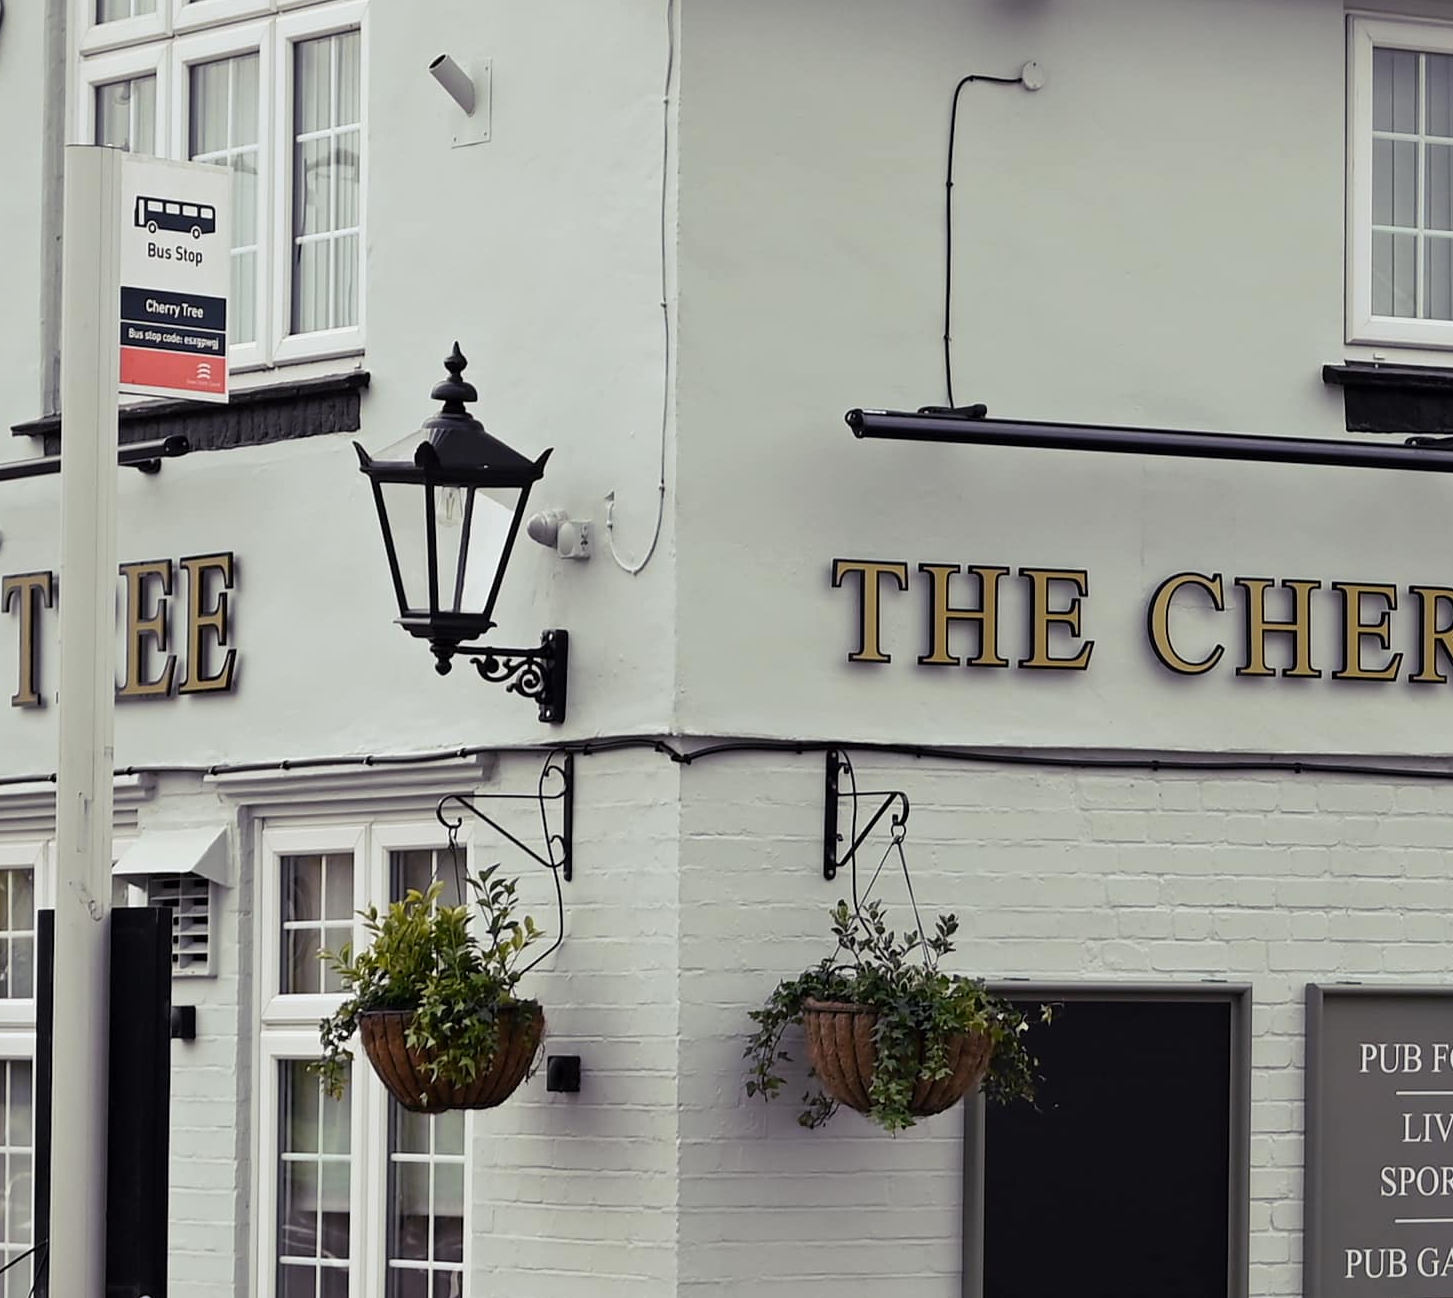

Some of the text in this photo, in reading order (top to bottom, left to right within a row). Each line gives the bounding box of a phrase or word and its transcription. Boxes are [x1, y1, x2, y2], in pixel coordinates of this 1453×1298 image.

[148, 242, 203, 267] Bus Stop
[145, 298, 204, 318] Cherry Tree
[128, 327, 144, 339] Bus
[145, 331, 161, 343] stop
[2, 551, 238, 708] TEE
[830, 558, 1095, 672] THE
[1359, 1043, 1422, 1073] PUB
[1345, 1248, 1407, 1279] PUB
